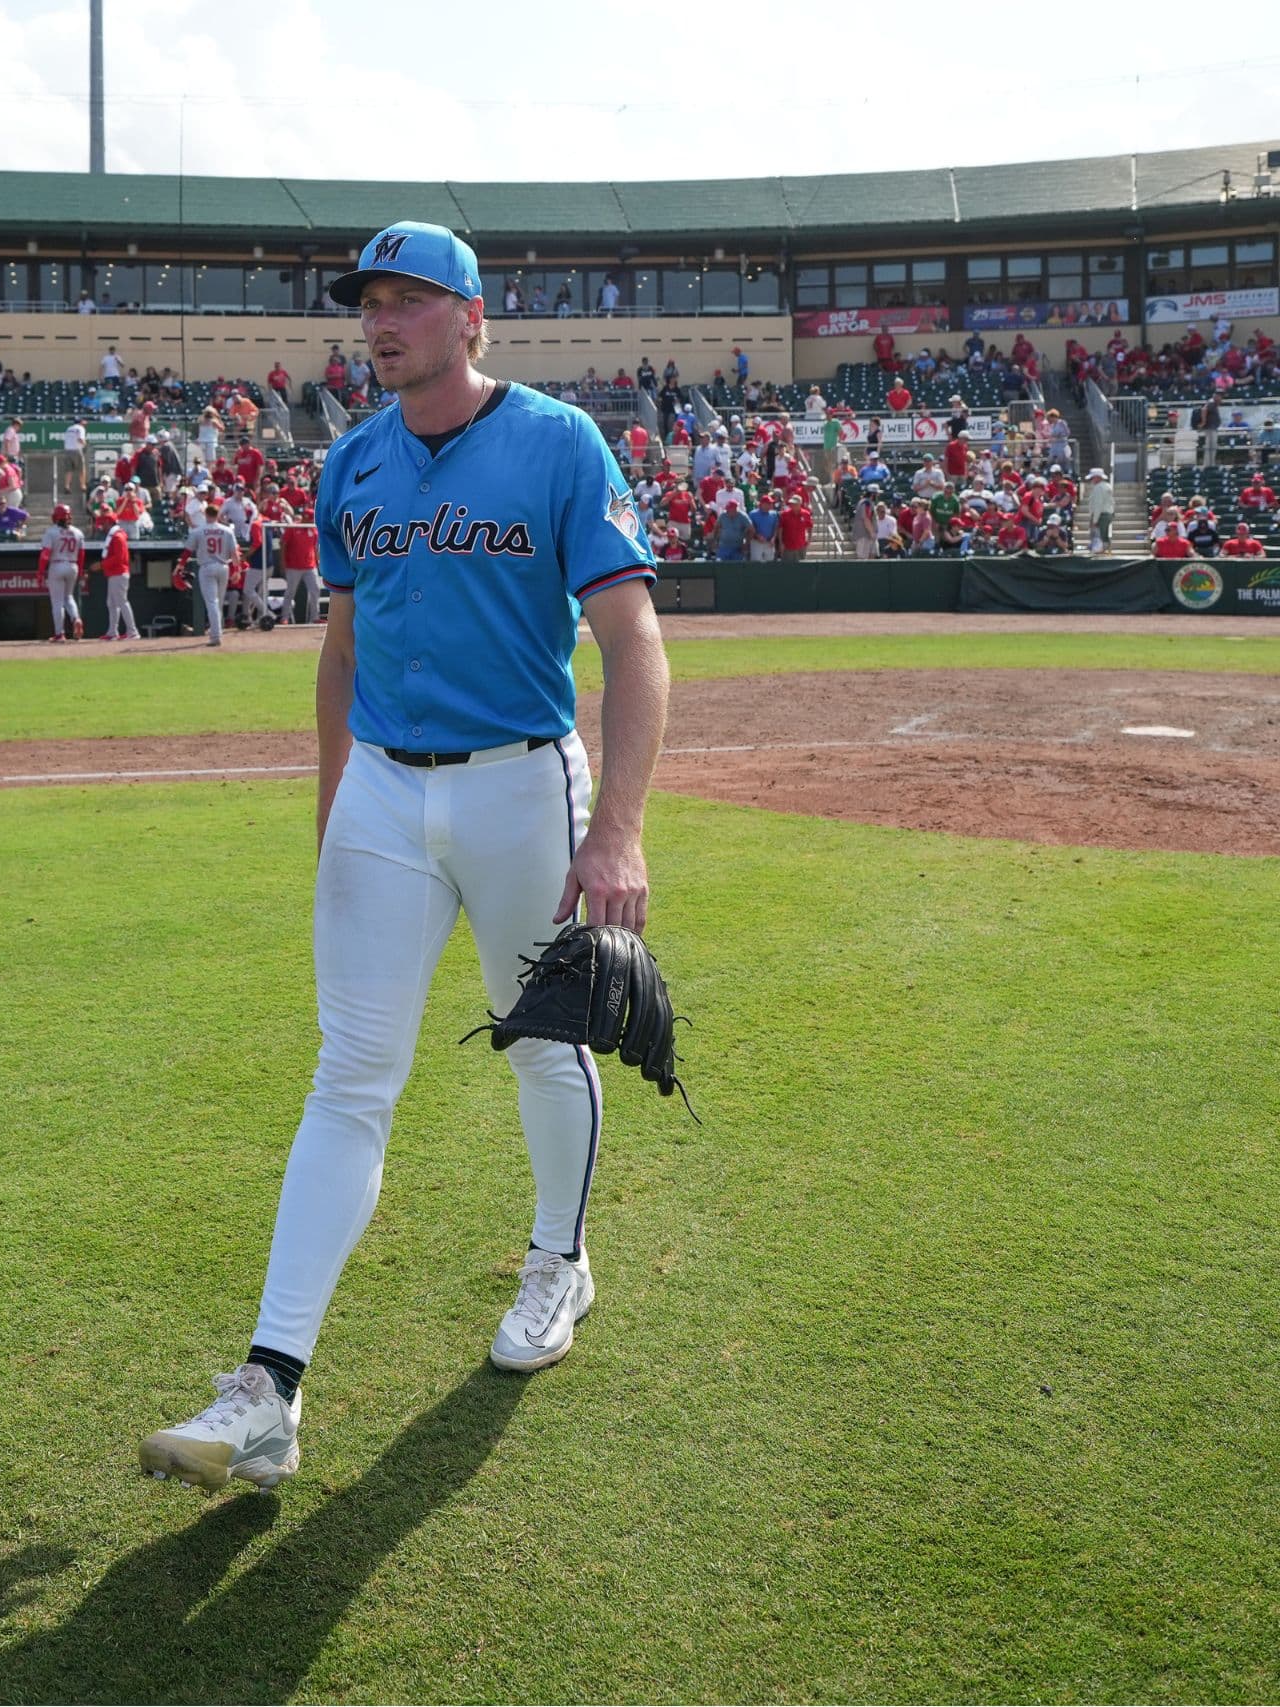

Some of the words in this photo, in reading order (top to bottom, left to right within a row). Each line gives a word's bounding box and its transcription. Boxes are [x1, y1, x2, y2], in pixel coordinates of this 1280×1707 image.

[1183, 293, 1226, 308] JMS
[818, 318, 870, 336] GATOR
[341, 502, 536, 560] Marlins
[59, 537, 77, 553] 70
[206, 537, 223, 554] 91
[1237, 588, 1254, 601] THE
[607, 976, 625, 1017] A2K
